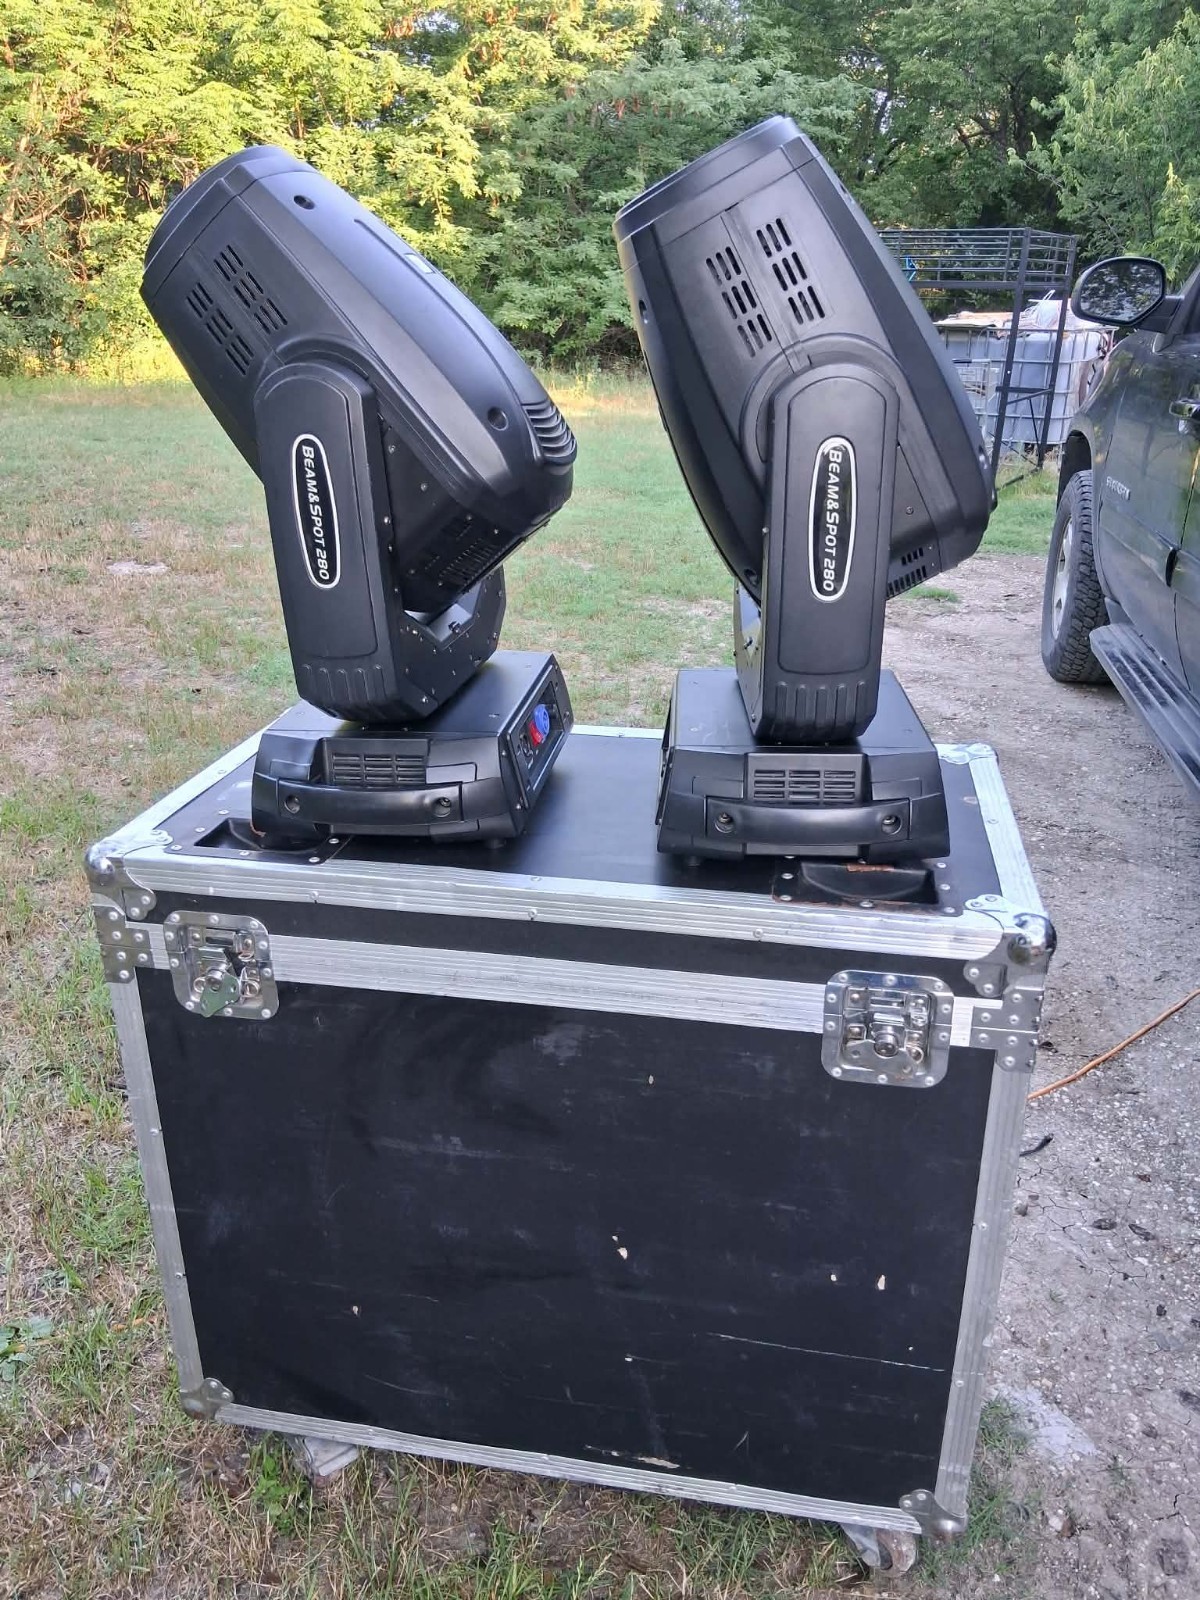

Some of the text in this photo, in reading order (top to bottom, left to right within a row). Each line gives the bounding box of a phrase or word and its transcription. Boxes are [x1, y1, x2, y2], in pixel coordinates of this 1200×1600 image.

[302, 445, 330, 580] BEAM&SPOT 280
[823, 449, 842, 591] BEAM&SPOT 280
